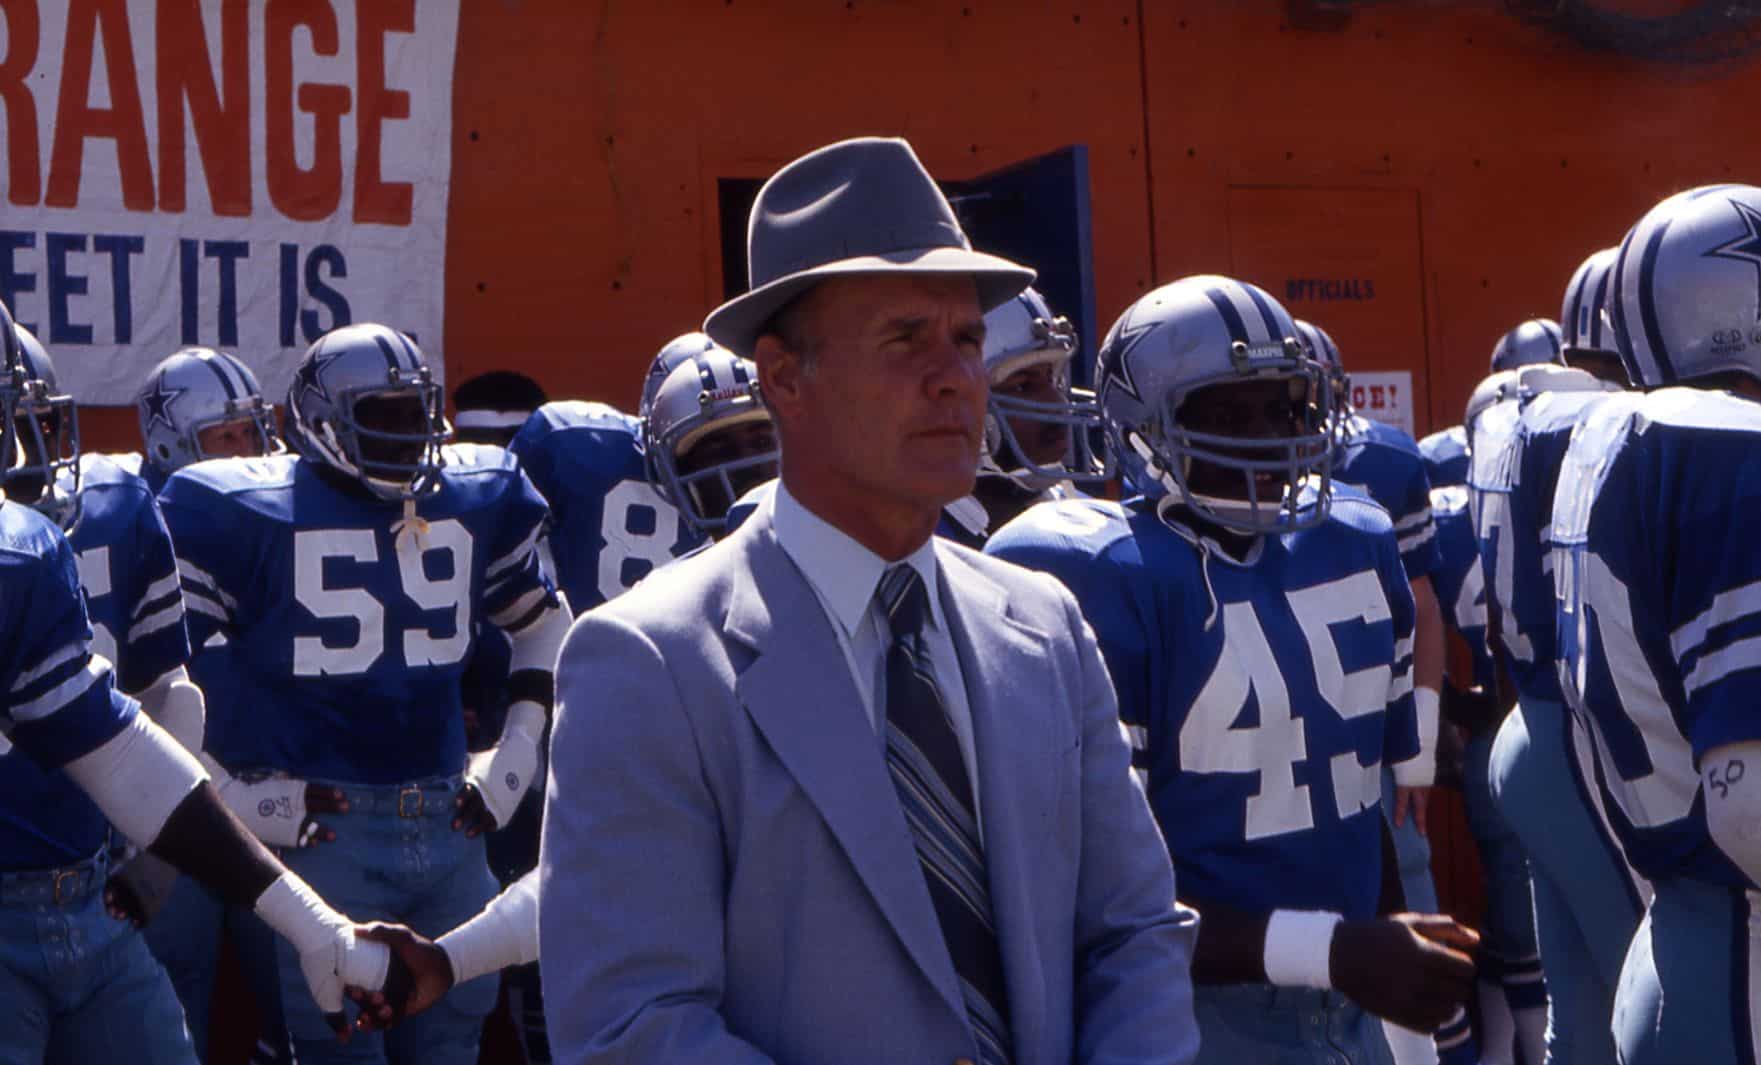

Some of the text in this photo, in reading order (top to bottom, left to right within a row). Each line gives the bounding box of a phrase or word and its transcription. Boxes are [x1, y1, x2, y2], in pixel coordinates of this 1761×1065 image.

[0, 229, 144, 345] EET
[180, 239, 249, 347] IT
[1286, 279, 1375, 299] OFFICIALS
[293, 518, 473, 676] 59
[1179, 568, 1393, 841] 45
[1708, 759, 1745, 800] 50
